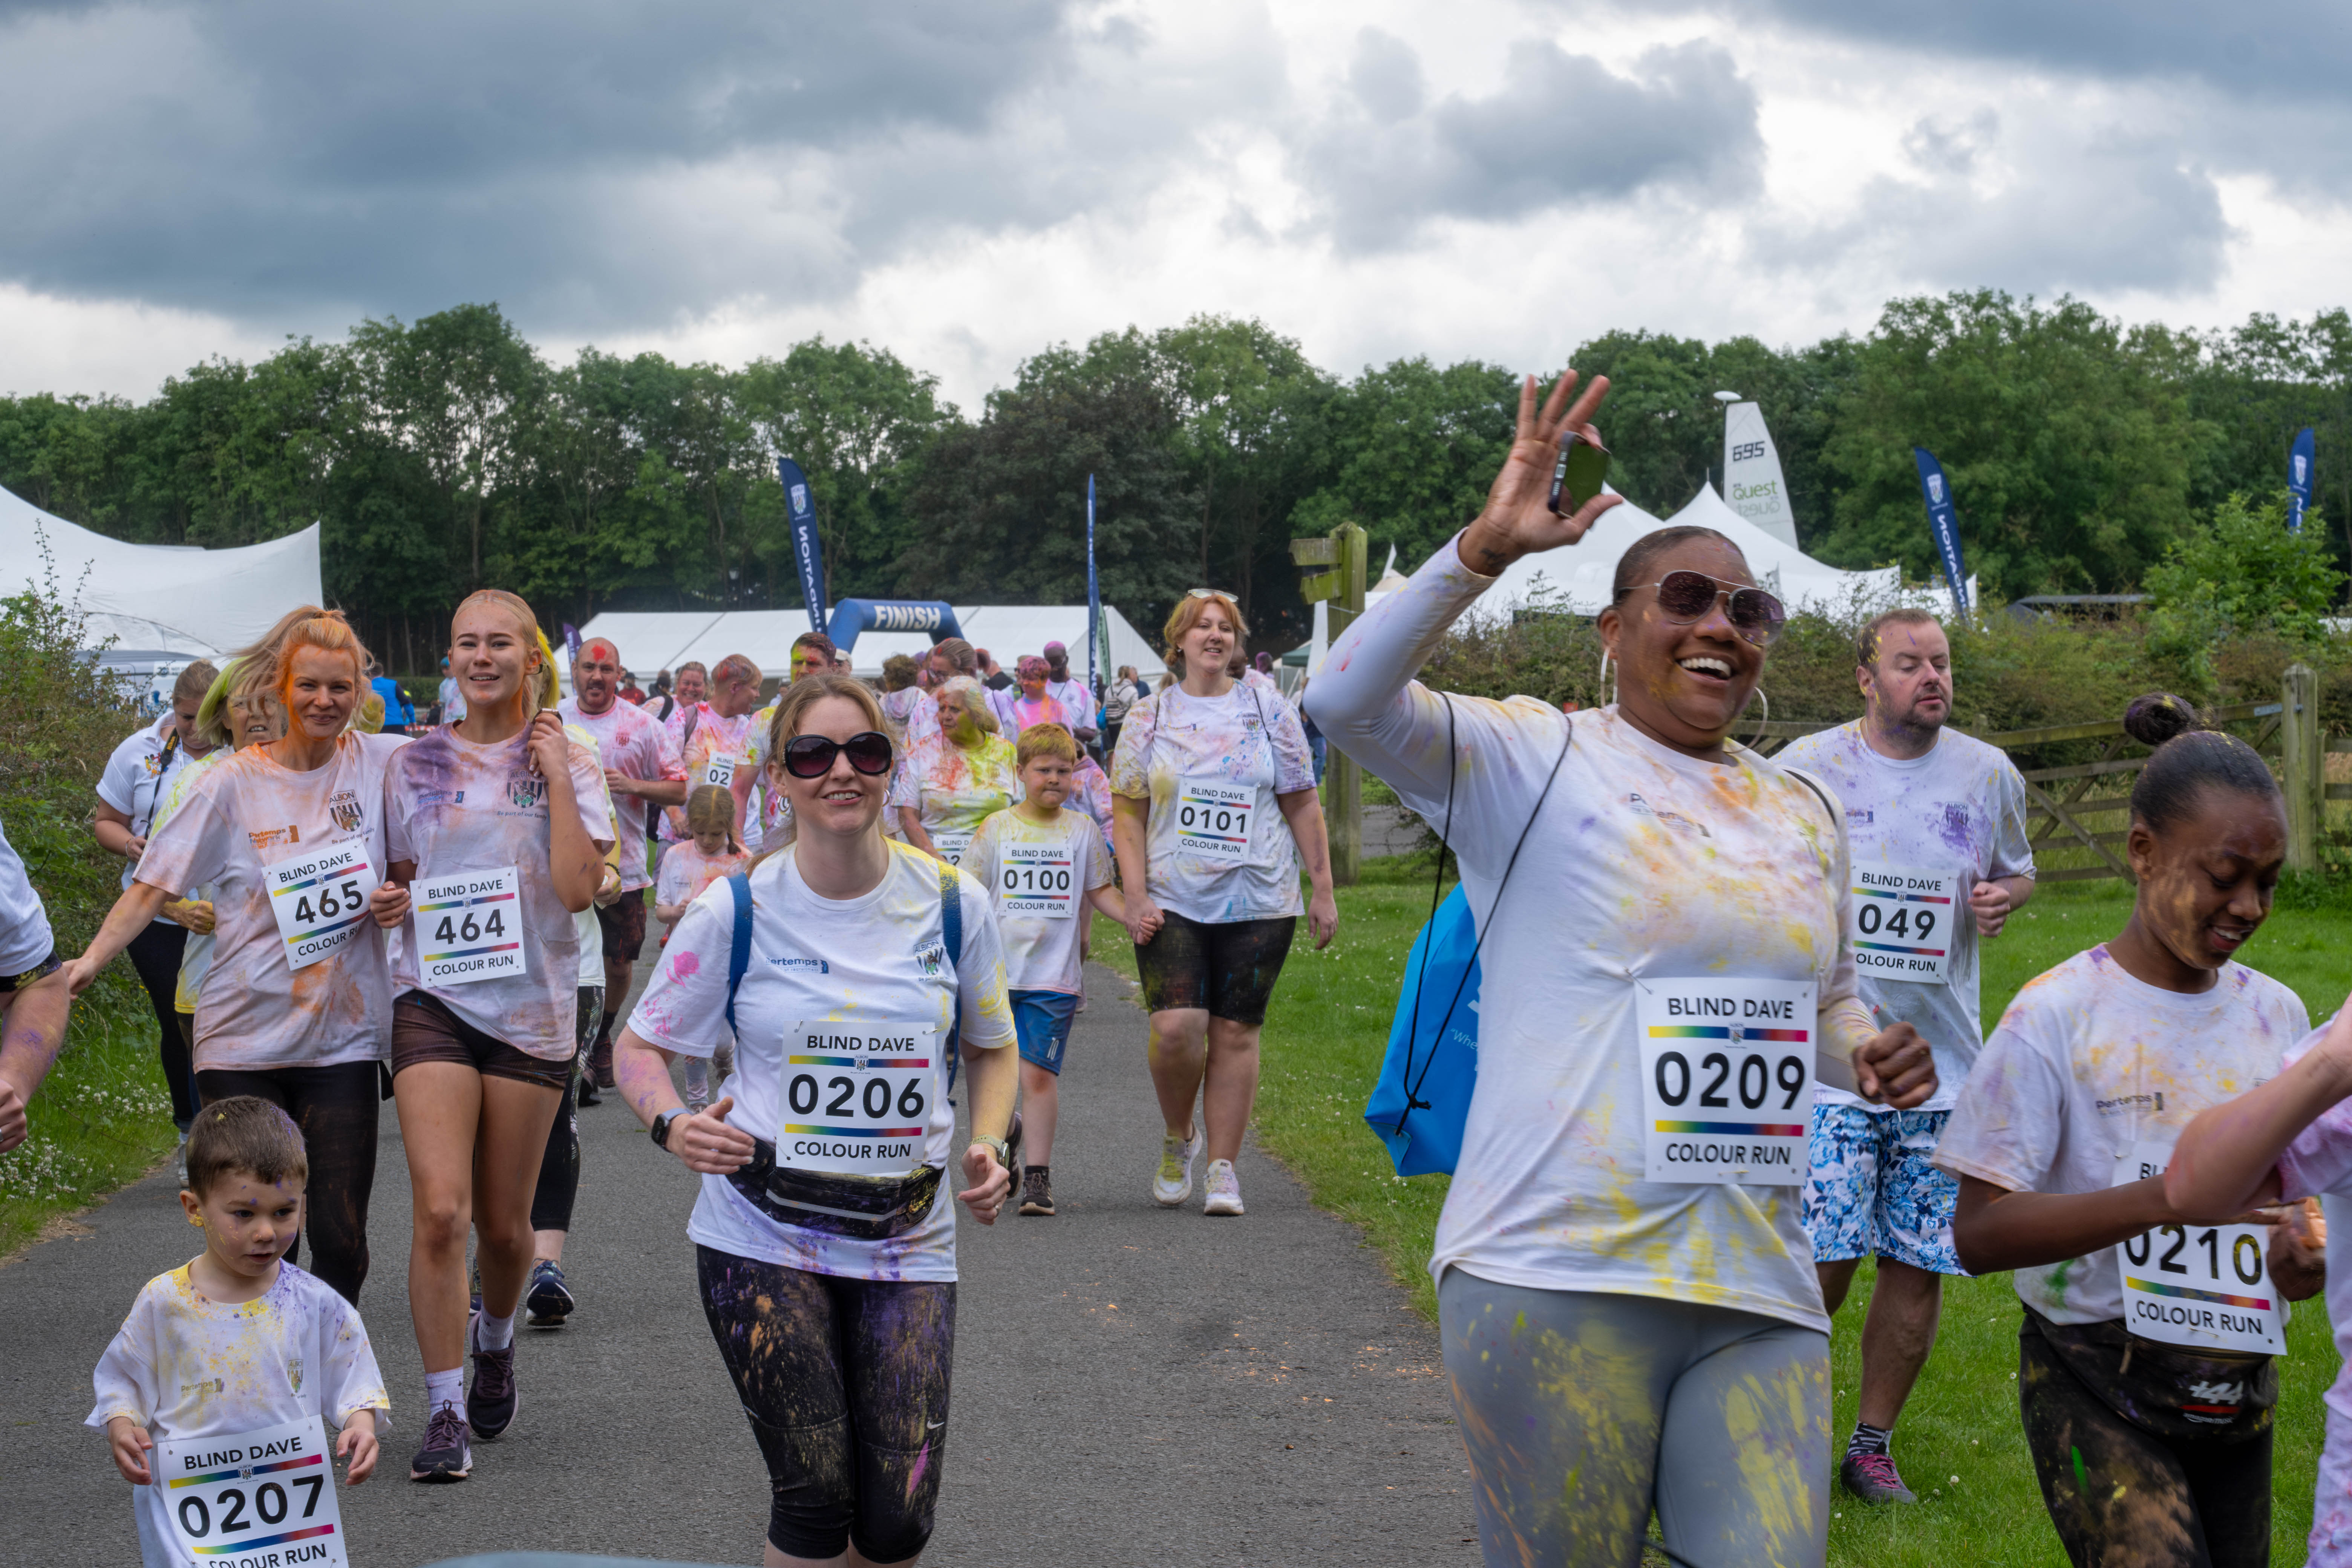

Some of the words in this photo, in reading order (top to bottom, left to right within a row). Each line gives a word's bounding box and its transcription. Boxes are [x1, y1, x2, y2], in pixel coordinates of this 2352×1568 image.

[1733, 441, 1765, 461] 695
[1733, 481, 1778, 501] Quest
[874, 606, 941, 630] FINISH
[167, 736, 176, 750] Nikon
[710, 769, 729, 786] 02
[329, 792, 355, 804] ALBION
[1191, 787, 1218, 798] BLIND
[1220, 790, 1245, 801] DAVE
[1180, 806, 1246, 833] 0101
[1042, 850, 1064, 858] DAVE
[1182, 838, 1219, 851] COLOUR
[1221, 842, 1241, 854] RUN
[279, 864, 317, 883] BLIND
[319, 852, 353, 870] DAVE
[428, 885, 466, 899] BLIND
[470, 879, 503, 893] DAVE
[1003, 869, 1070, 891] 0100
[1862, 873, 1903, 887] BLIND
[1908, 878, 1942, 891] DAVE
[295, 880, 363, 923] 465
[1007, 901, 1045, 910] COLOUR
[1047, 902, 1065, 911] RUN
[435, 909, 505, 945] 464
[1858, 903, 1936, 940] 049
[298, 932, 347, 956] COLOUR
[914, 940, 939, 953] ALBION
[433, 960, 484, 975] COLOUR
[488, 955, 514, 968] RUN
[767, 957, 818, 967] ertemps
[1856, 953, 1905, 969] OLOUR
[1909, 959, 1936, 972] RUN
[1667, 997, 1736, 1016] BLIND
[1744, 999, 1794, 1019] DAVE
[807, 1035, 862, 1050] BLIND
[868, 1038, 914, 1052] DAVE
[1450, 1028, 1478, 1049] “Whe
[1655, 1051, 1805, 1110] 0209
[788, 1073, 925, 1118] 0206
[794, 1141, 871, 1159] COLOUR
[877, 1144, 911, 1158] RUN
[1666, 1143, 1746, 1164] COLOUR
[1752, 1145, 1791, 1164] RUN
[2125, 1225, 2262, 1286] 0210
[2136, 1300, 2215, 1329] COLOUR
[2220, 1314, 2263, 1334] RUN
[181, 1380, 213, 1392] Pertemps
[184, 1449, 243, 1470] BLIND
[249, 1436, 303, 1459] DAVE
[178, 1474, 325, 1538] 0207
[285, 1544, 327, 1565] RUN
